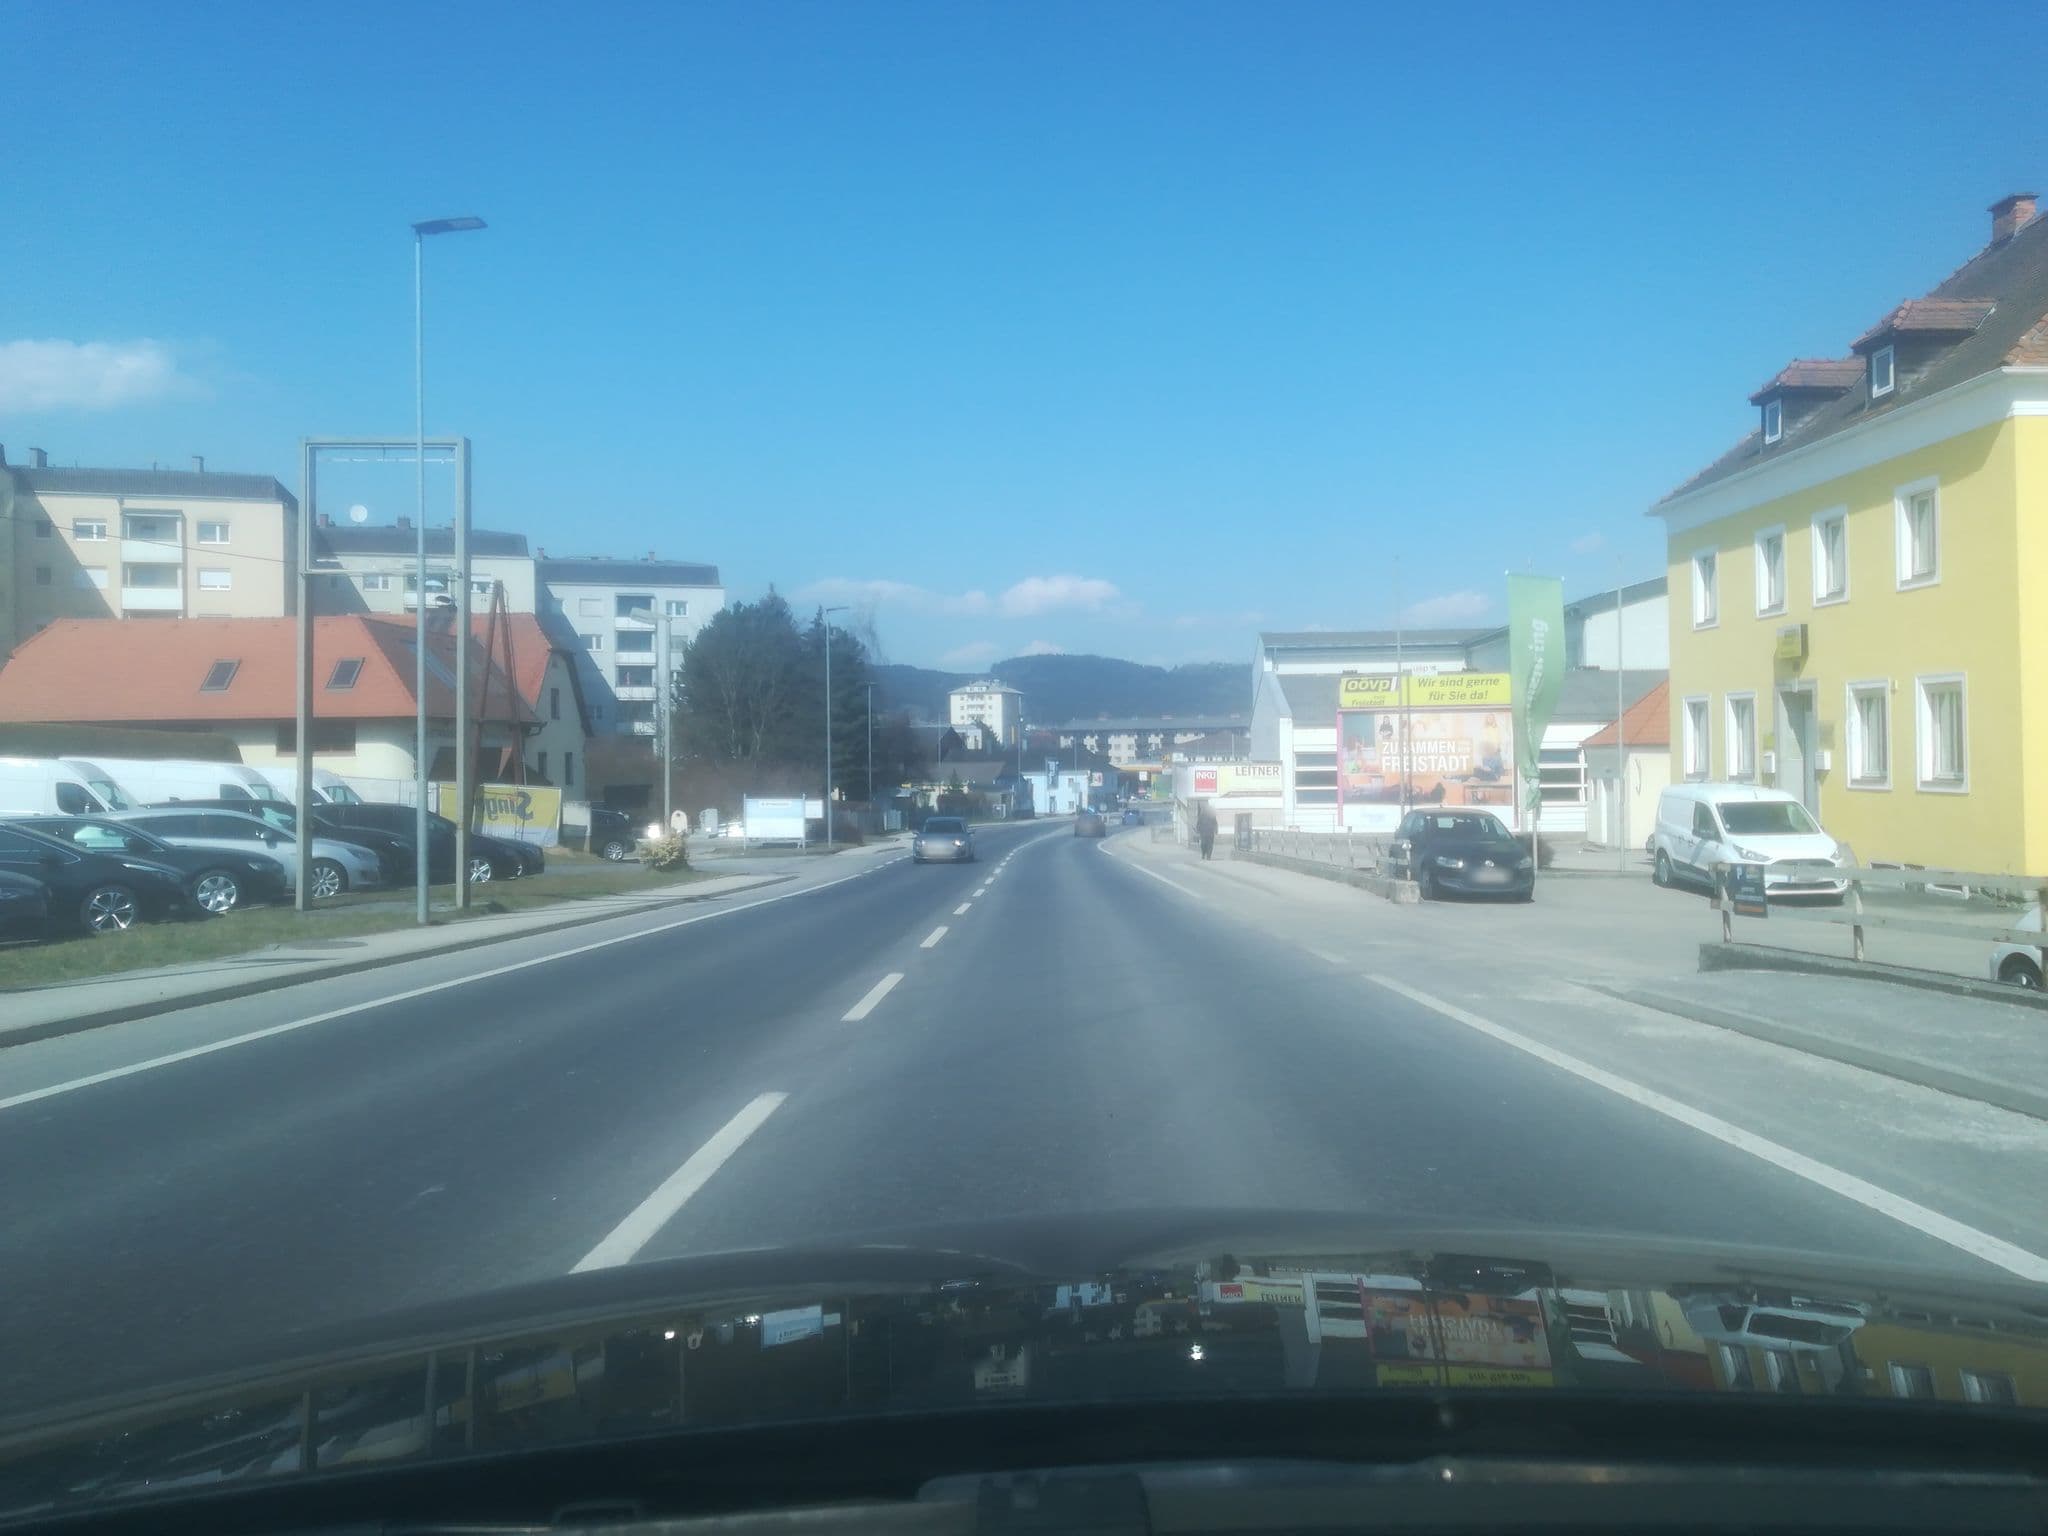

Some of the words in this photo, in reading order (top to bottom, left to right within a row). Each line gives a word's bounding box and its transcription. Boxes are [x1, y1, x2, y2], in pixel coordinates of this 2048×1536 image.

[1417, 677, 1436, 688] Wir
[1439, 676, 1464, 687] sind
[1466, 677, 1500, 690] gerne
[1428, 690, 1446, 702] für
[1448, 690, 1467, 701] Sie
[1469, 690, 1489, 700] da!
[1381, 740, 1456, 754] ZUSAMMEN
[1381, 755, 1470, 772] FREISTADT
[1196, 772, 1216, 780] INKU
[1235, 767, 1280, 776] LEITNER
